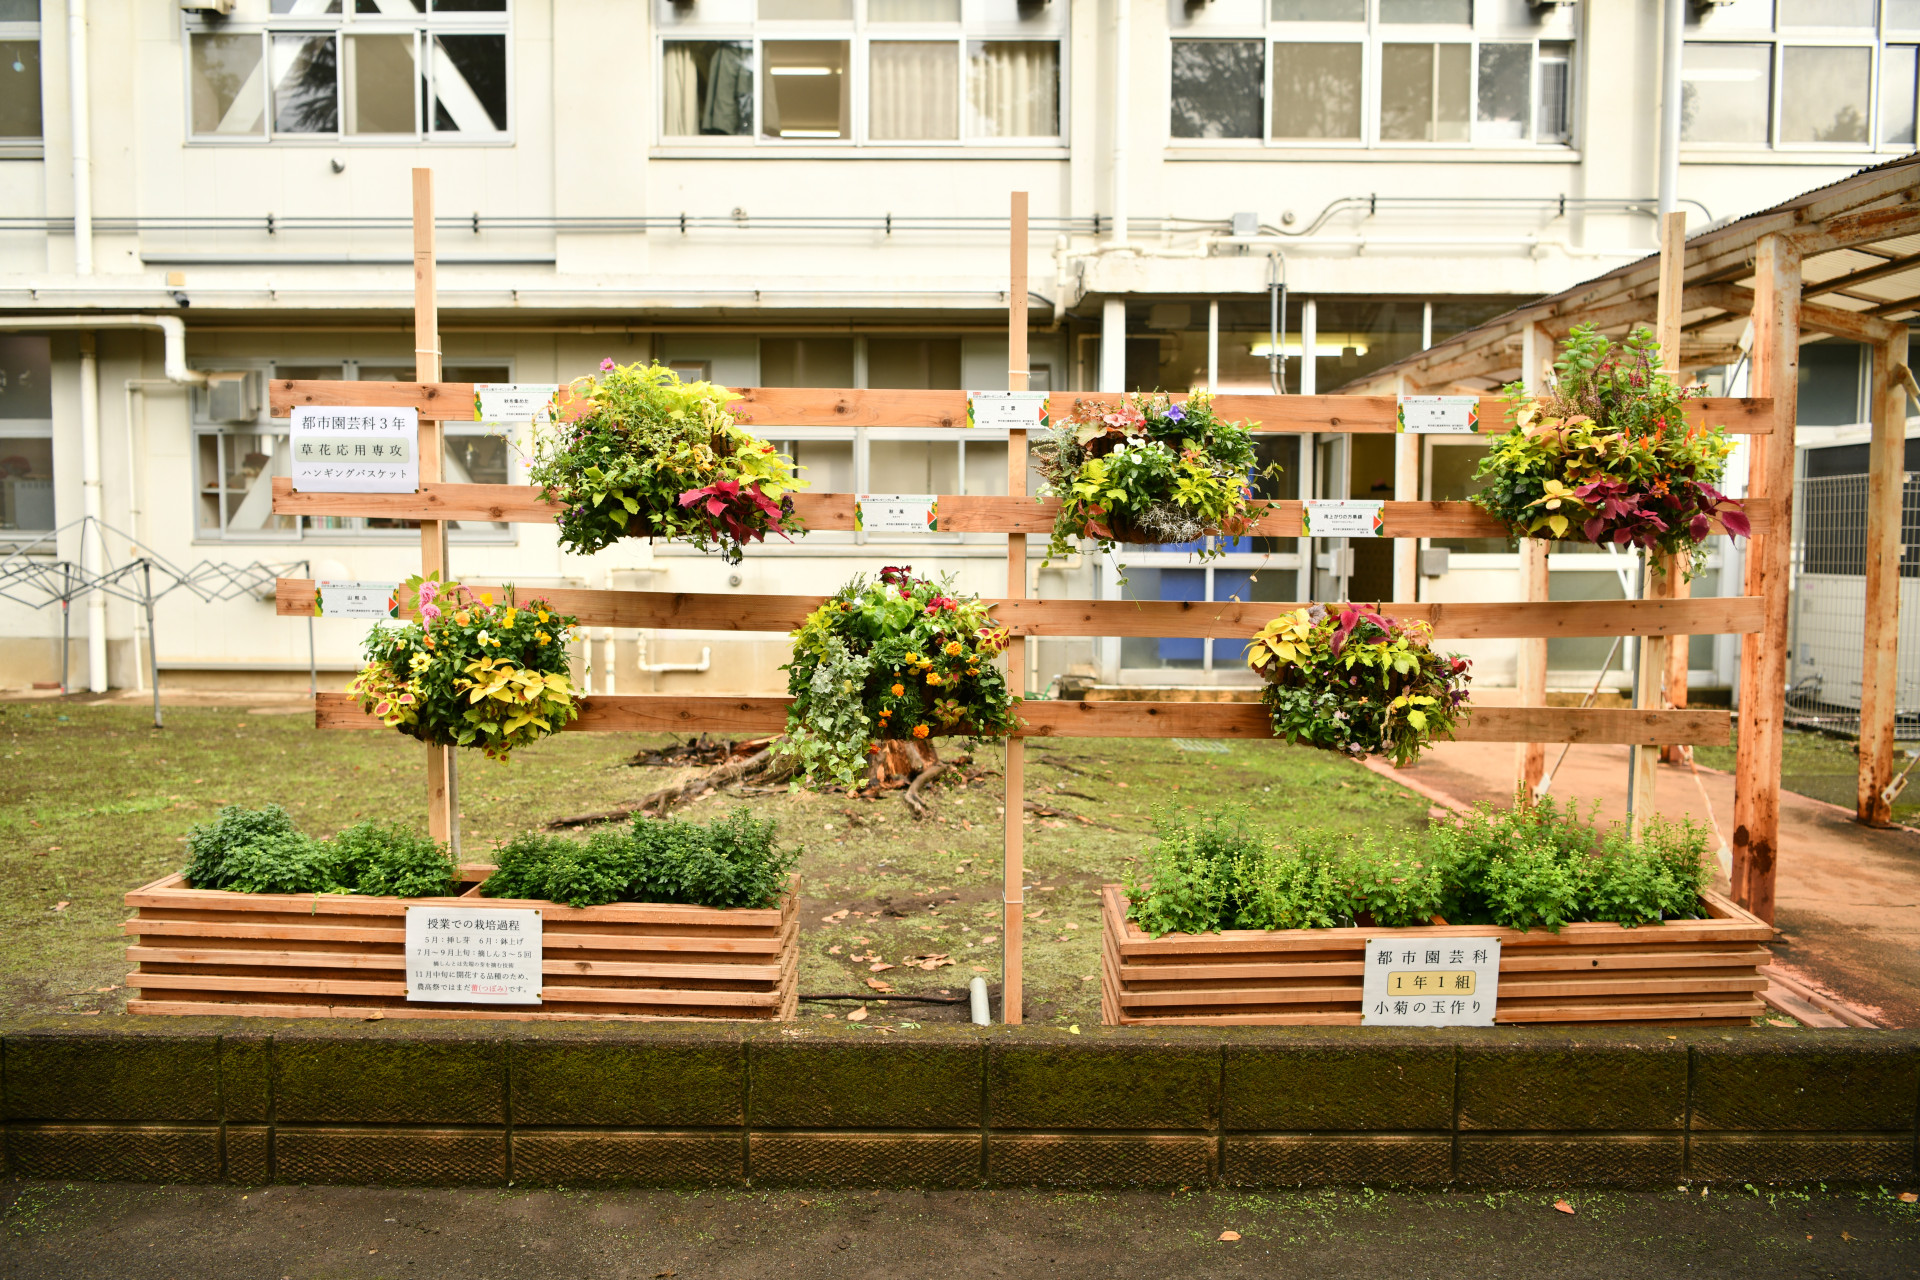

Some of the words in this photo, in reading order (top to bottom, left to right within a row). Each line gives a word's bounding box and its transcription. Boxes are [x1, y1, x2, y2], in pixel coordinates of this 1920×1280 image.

[302, 415, 406, 431] 都市園芸科3年
[300, 443, 403, 457] 草花応用専攻
[302, 468, 407, 479] ハンギングバスケット
[427, 917, 520, 931] 授業での栽培過程
[1377, 949, 1488, 965] 都市園芸科
[1395, 974, 1471, 990] 1年1組
[1374, 1000, 1481, 1015] 小菊の玉作り
